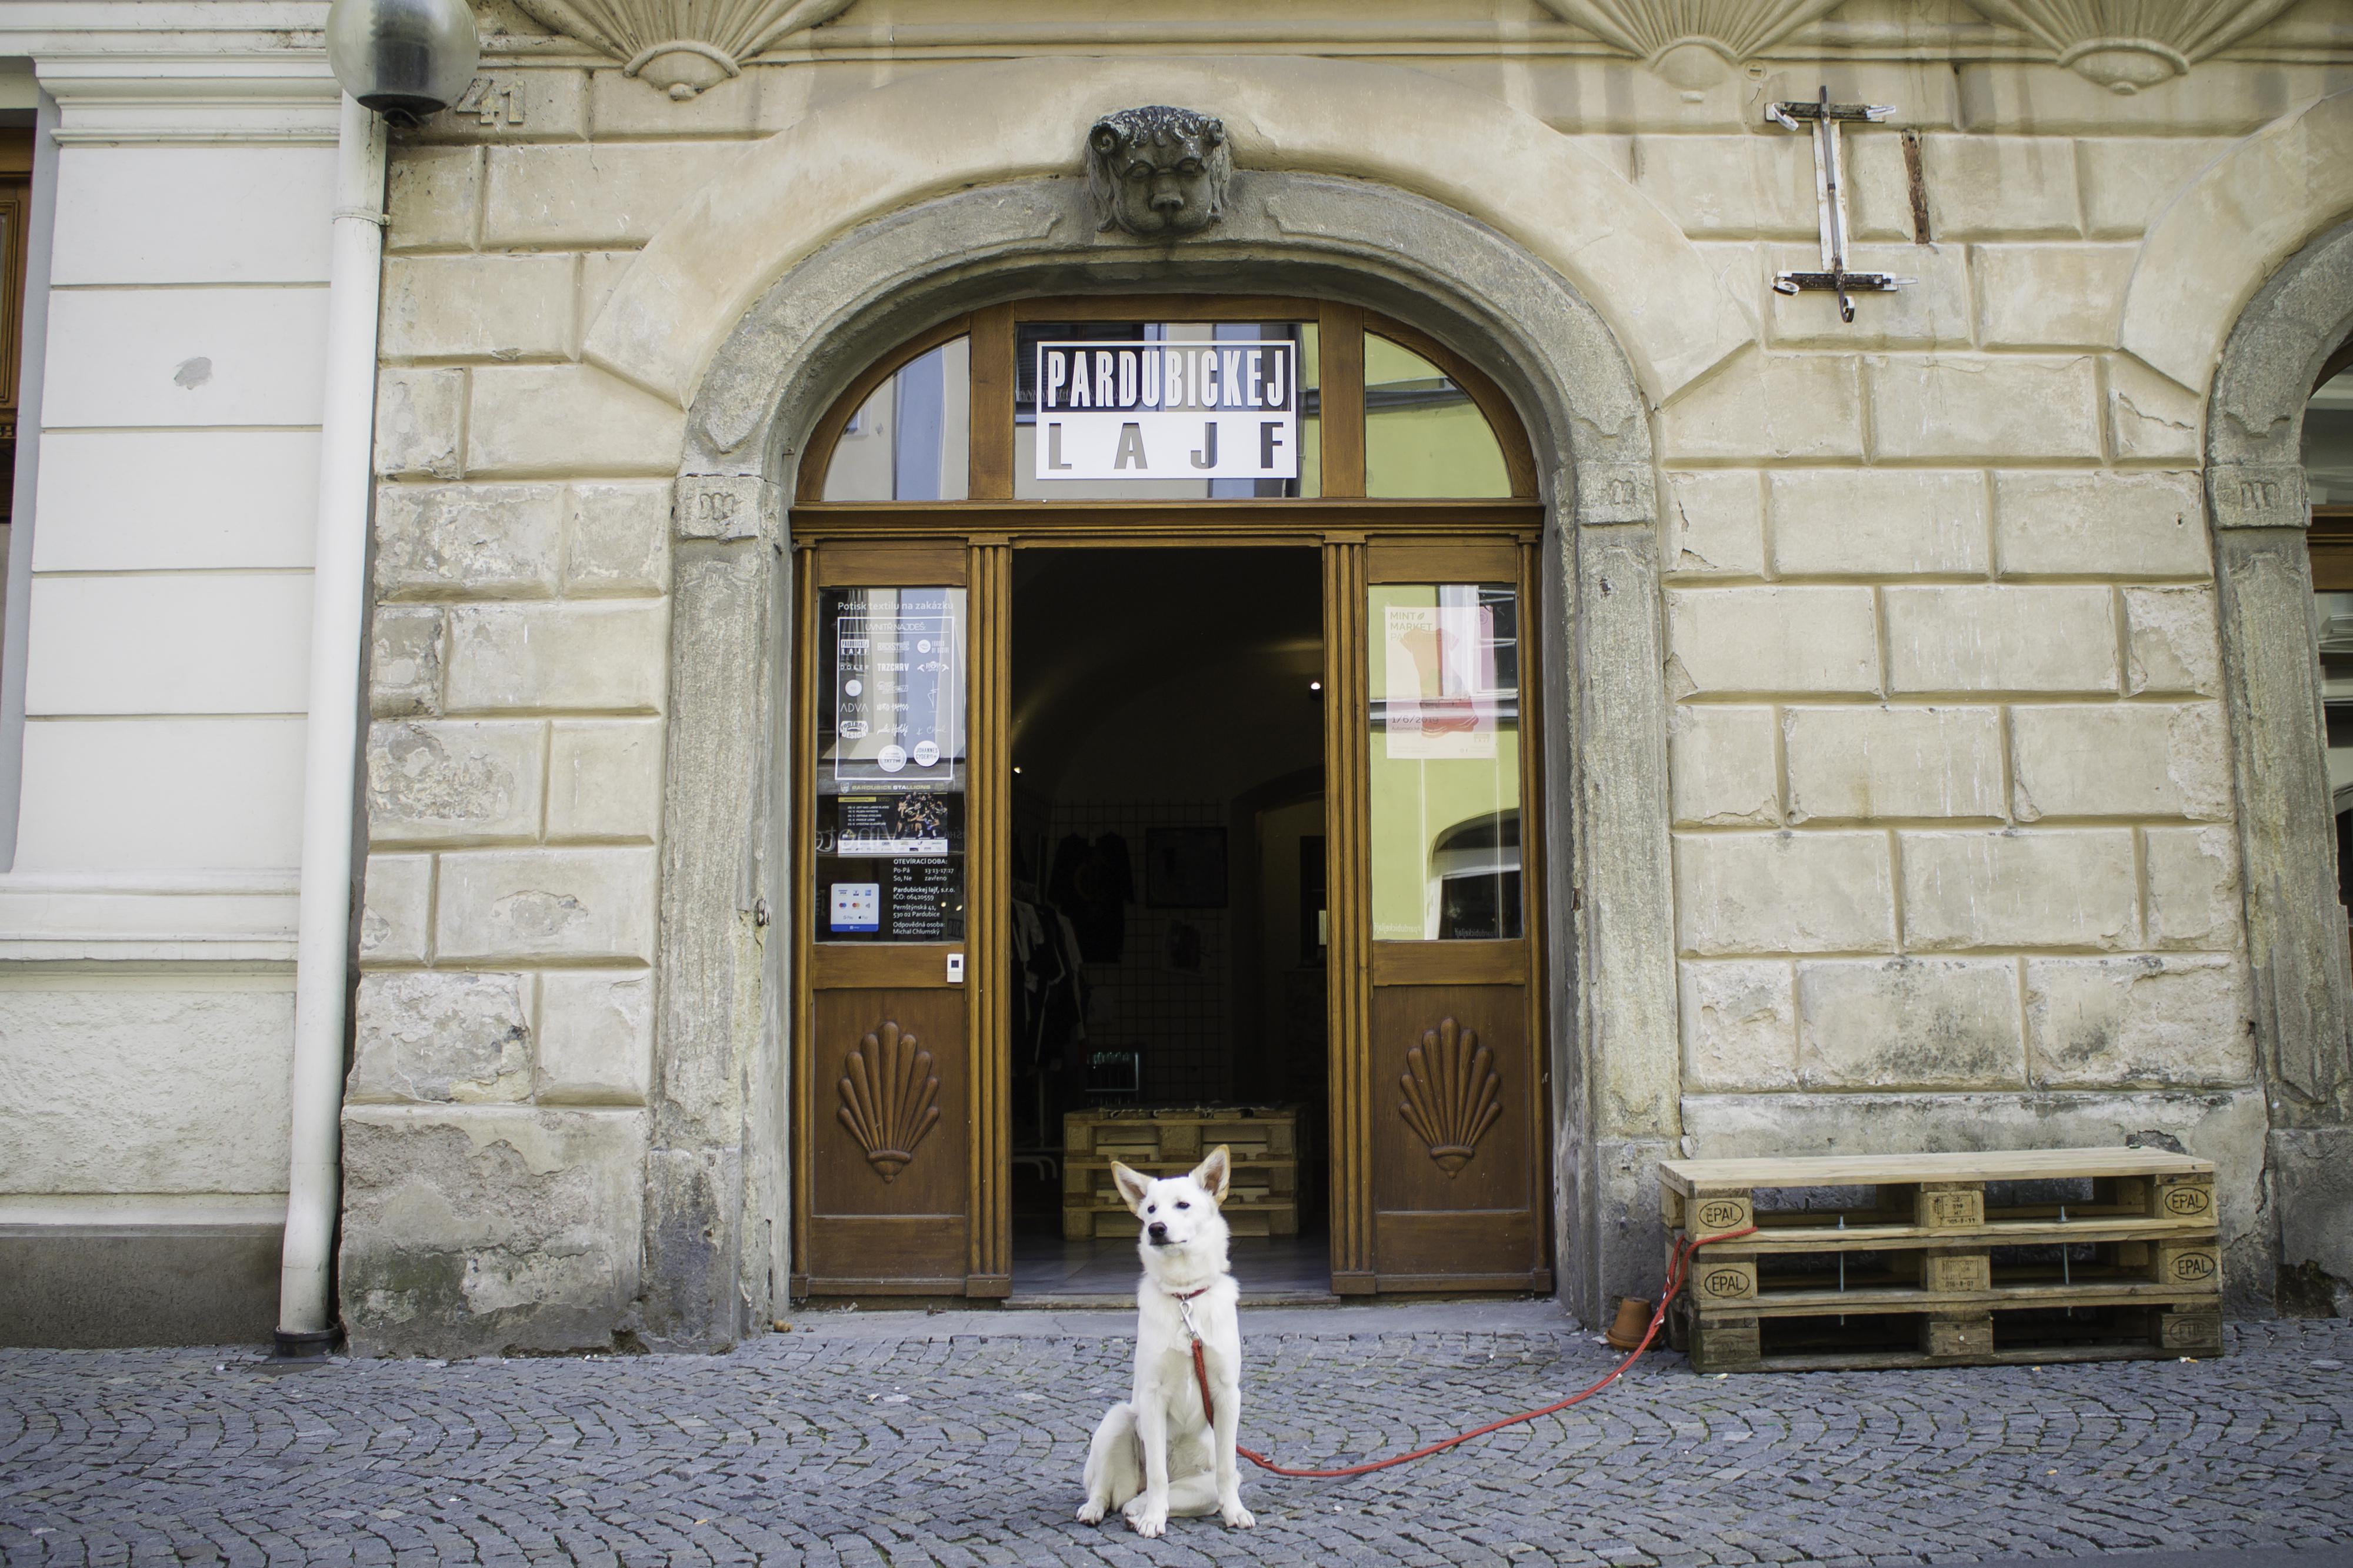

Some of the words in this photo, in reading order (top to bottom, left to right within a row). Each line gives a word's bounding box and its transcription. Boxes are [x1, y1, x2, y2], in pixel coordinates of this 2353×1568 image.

[456, 78, 525, 125] 41
[1048, 350, 1284, 408] PARDUBICKEJ
[1048, 422, 1284, 470] LAJF
[838, 602, 866, 610] Potisk
[869, 602, 899, 610] textilu
[915, 602, 954, 610] zakázku
[1390, 612, 1416, 620] MINT
[865, 622, 892, 631] UVNITŘ
[1390, 623, 1433, 632] MARKET
[877, 663, 909, 672] TRZCHRV
[1392, 715, 1439, 724] 1/6/2019
[842, 729, 866, 739] DESIGN
[2172, 1194, 2204, 1209] EPAL
[1707, 1207, 1737, 1223] EPAL
[2178, 1257, 2208, 1275] EPAL
[1712, 1276, 1743, 1292] EPAL
